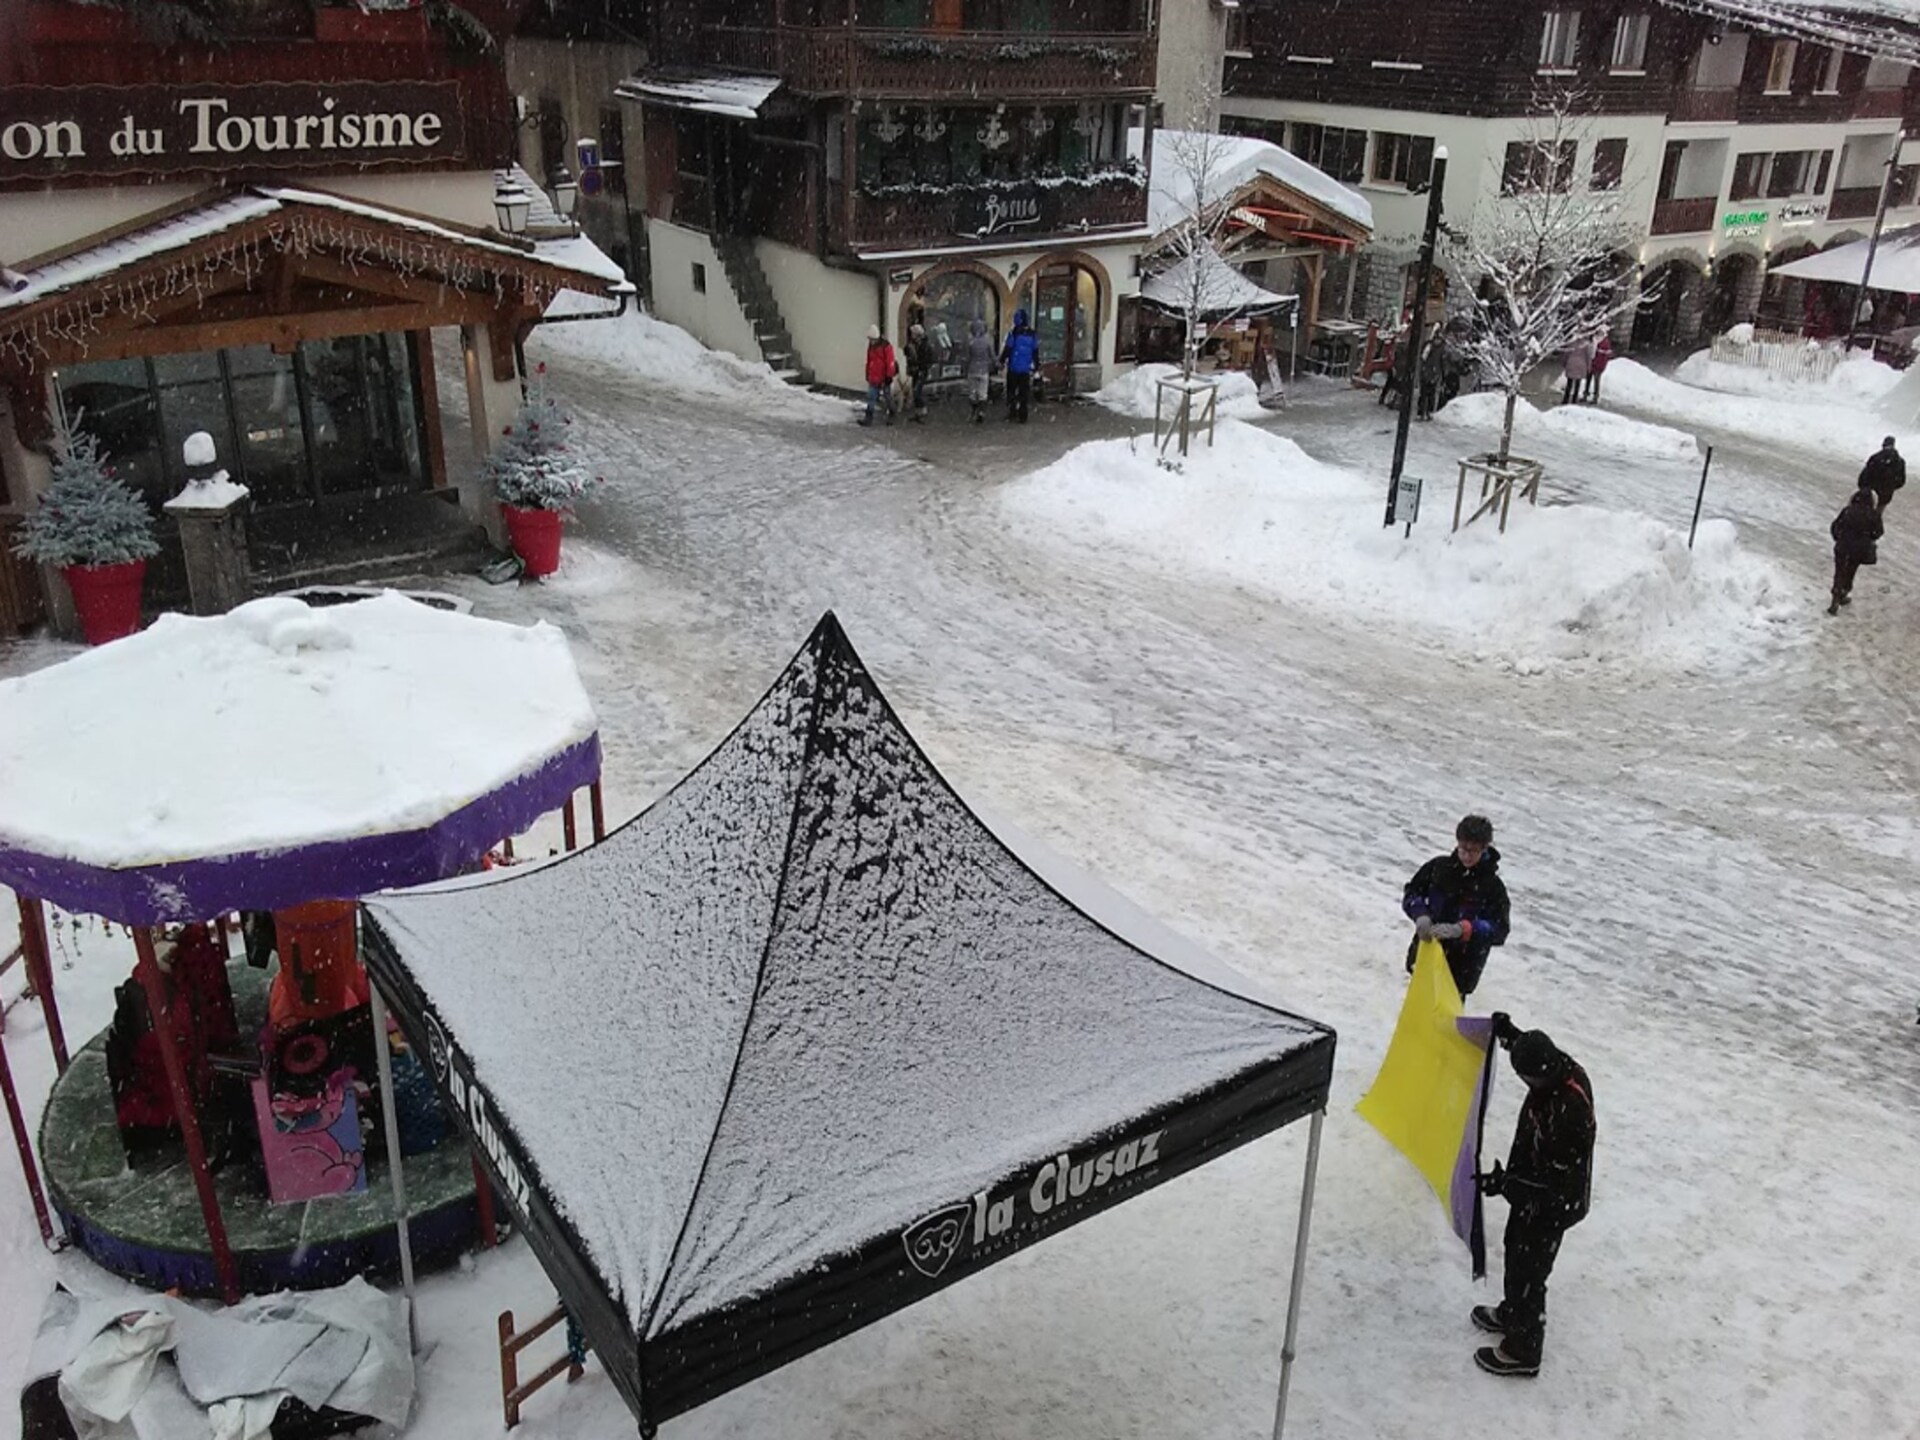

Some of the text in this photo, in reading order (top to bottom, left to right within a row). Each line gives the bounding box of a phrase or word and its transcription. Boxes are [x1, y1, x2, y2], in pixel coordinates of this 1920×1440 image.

[1, 98, 443, 160] on du Tourisme
[447, 1044, 530, 1218] la Clusaz
[972, 1129, 1164, 1246] la Clusaz
